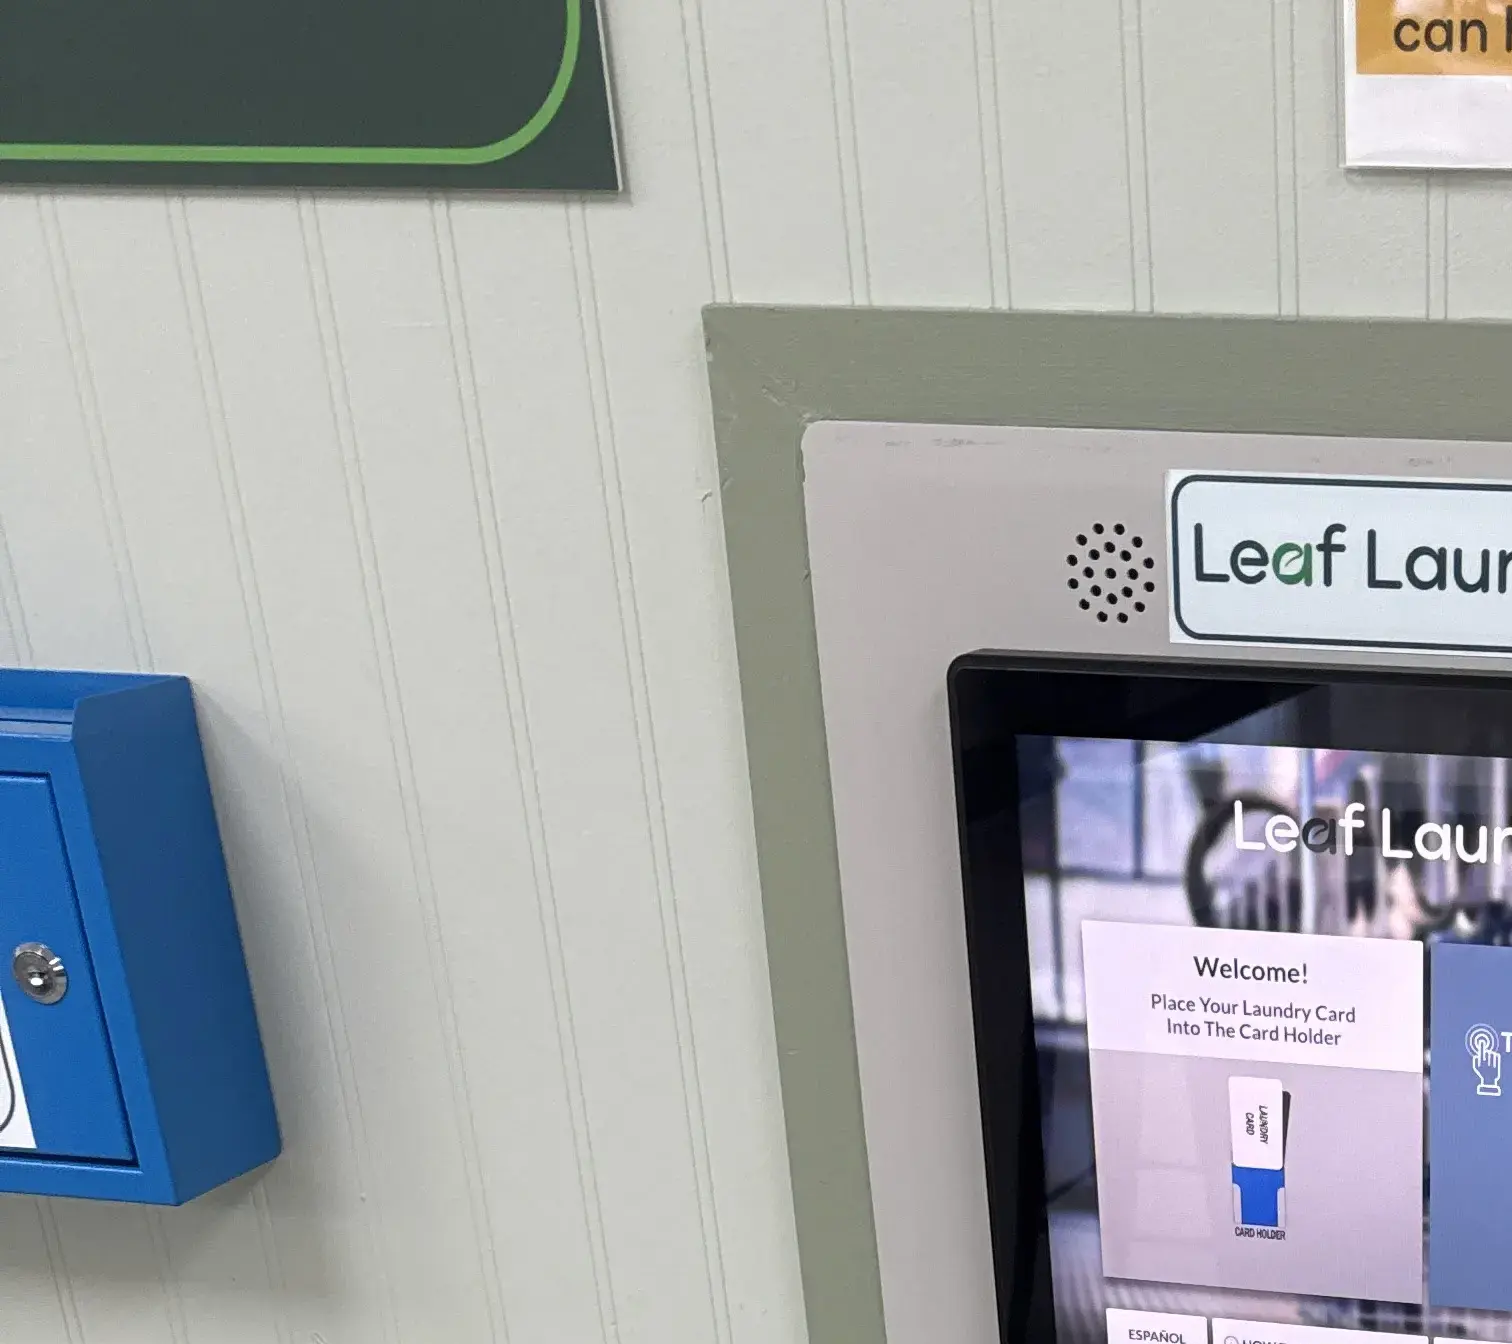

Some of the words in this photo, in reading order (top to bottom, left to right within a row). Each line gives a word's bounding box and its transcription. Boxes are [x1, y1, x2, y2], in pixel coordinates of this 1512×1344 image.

[1392, 17, 1487, 55] can
[1193, 521, 1346, 588] Leaf
[1233, 799, 1364, 857] Leaf
[1193, 955, 1309, 985] Welcome!
[1151, 993, 1196, 1014] Place
[1199, 997, 1239, 1016] Your
[1242, 1000, 1312, 1023] Laundry
[1315, 1005, 1357, 1024] Card
[1167, 1018, 1201, 1037] Into
[1203, 1020, 1236, 1039] The
[1239, 1023, 1280, 1042] Card
[1283, 1027, 1342, 1046] Holder
[1245, 1112, 1255, 1136] CARD
[1234, 1226, 1255, 1239] CARD
[1256, 1228, 1287, 1241] HOLDER
